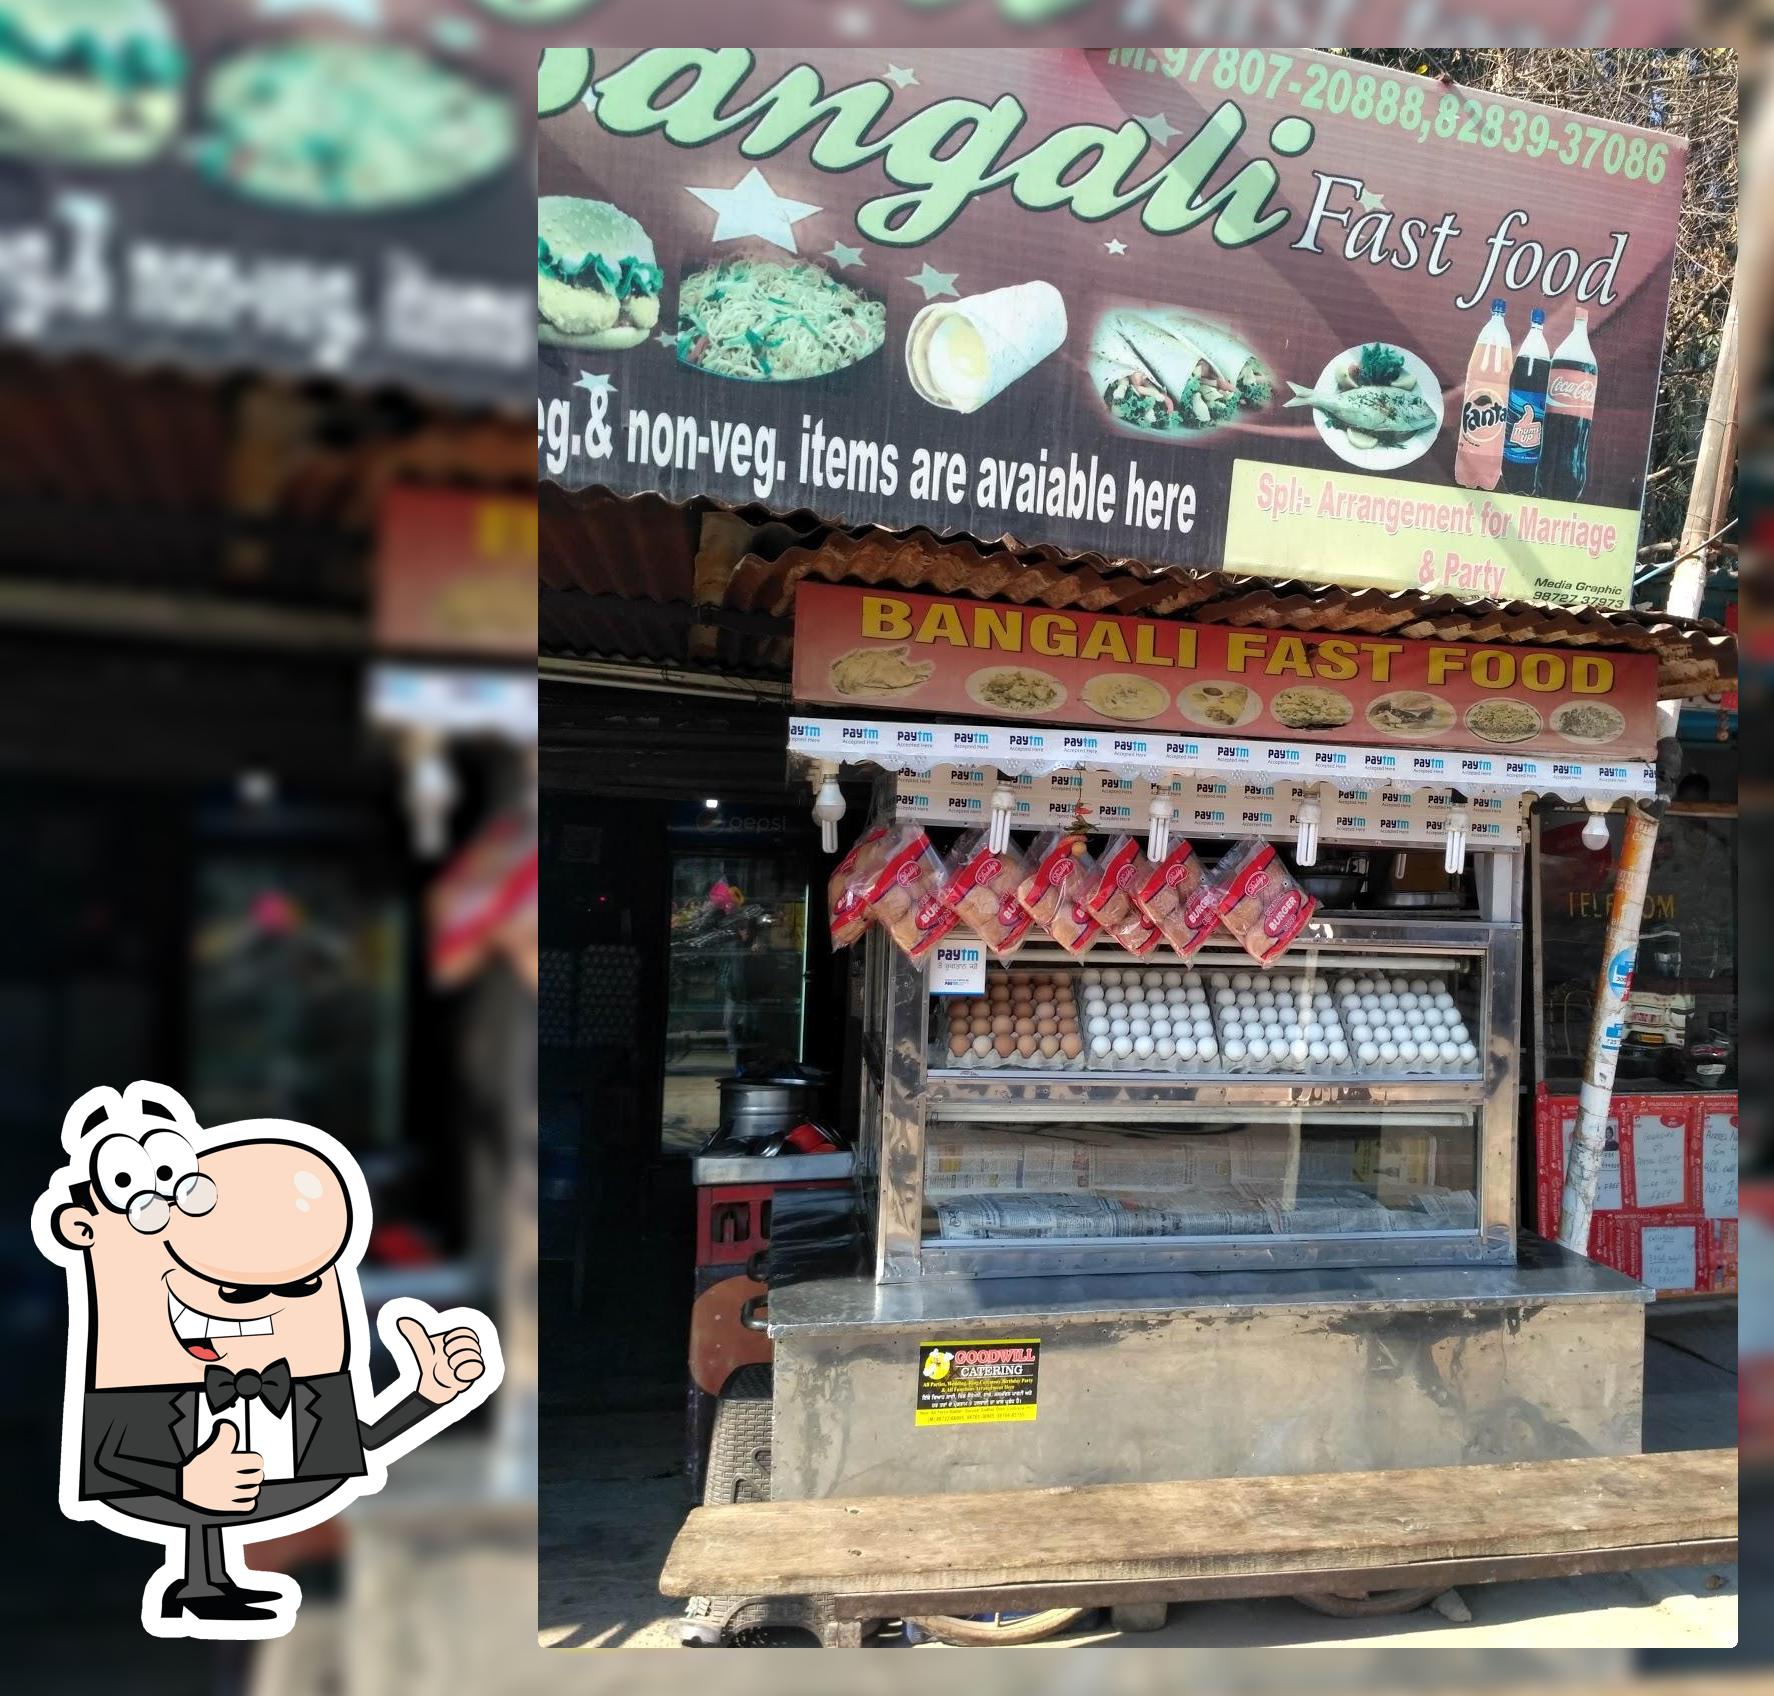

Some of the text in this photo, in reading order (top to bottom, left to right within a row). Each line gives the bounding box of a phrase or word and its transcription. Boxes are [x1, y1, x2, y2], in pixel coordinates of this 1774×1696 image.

[538, 48, 1315, 249] angali
[1291, 170, 1628, 311] Fast food
[627, 406, 785, 498] non-veg.
[799, 415, 899, 496] items
[910, 451, 968, 503] are
[976, 449, 1117, 523] avaiable
[1125, 462, 1197, 534] here
[1318, 481, 1474, 535] Arrangement
[1479, 500, 1513, 538] for
[1517, 506, 1618, 561] Marriage
[1418, 549, 1506, 599] & Party
[1534, 577, 1623, 595] Media Graphic
[1533, 591, 1578, 603] 98727
[860, 595, 1615, 695] BANGALI FAST FOOD
[1010, 775, 1032, 784] ytm
[1050, 803, 1076, 813] Pay
[1268, 896, 1297, 931] BURGER
[937, 948, 979, 961] Paytm
[954, 1348, 1036, 1365] GOODWILL
[960, 1365, 1024, 1377] CATERING
